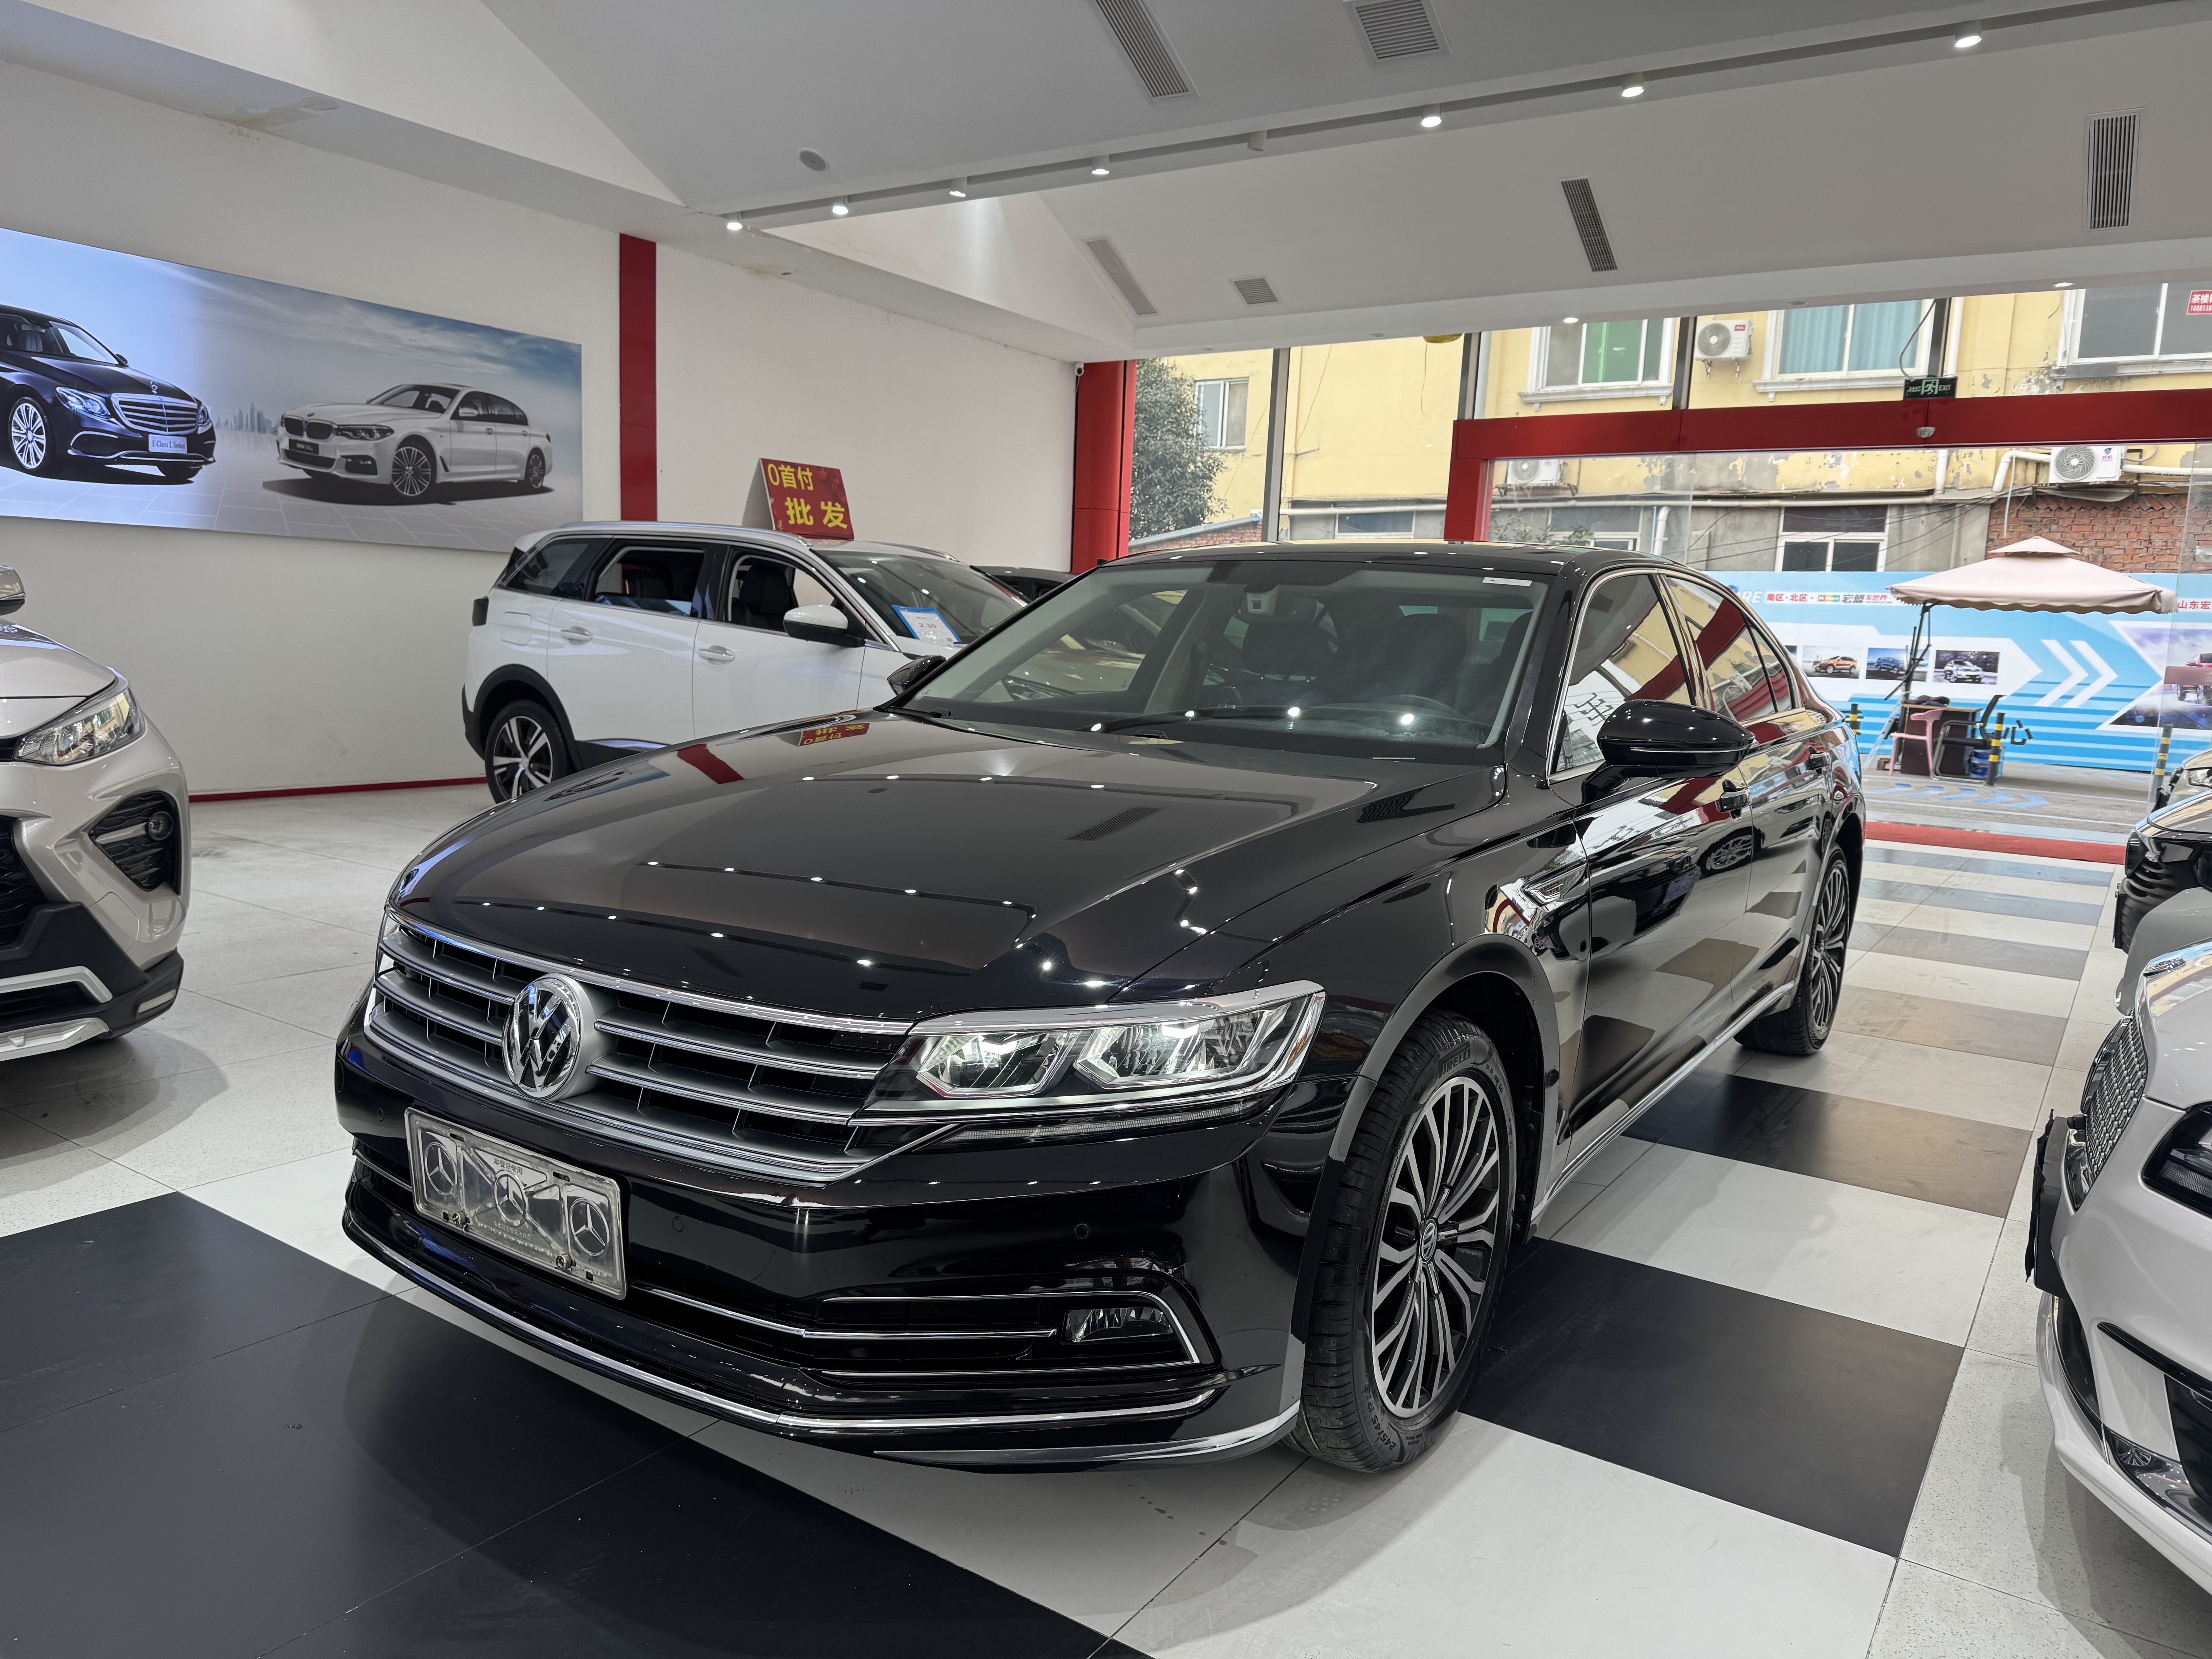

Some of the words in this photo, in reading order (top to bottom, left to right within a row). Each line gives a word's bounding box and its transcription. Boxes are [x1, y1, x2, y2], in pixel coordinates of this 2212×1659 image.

[768, 463, 814, 491] 0首付
[785, 497, 848, 529] 批发
[2177, 600, 2212, 610] 山东宏
[1437, 1041, 1470, 1079] PIRELLI
